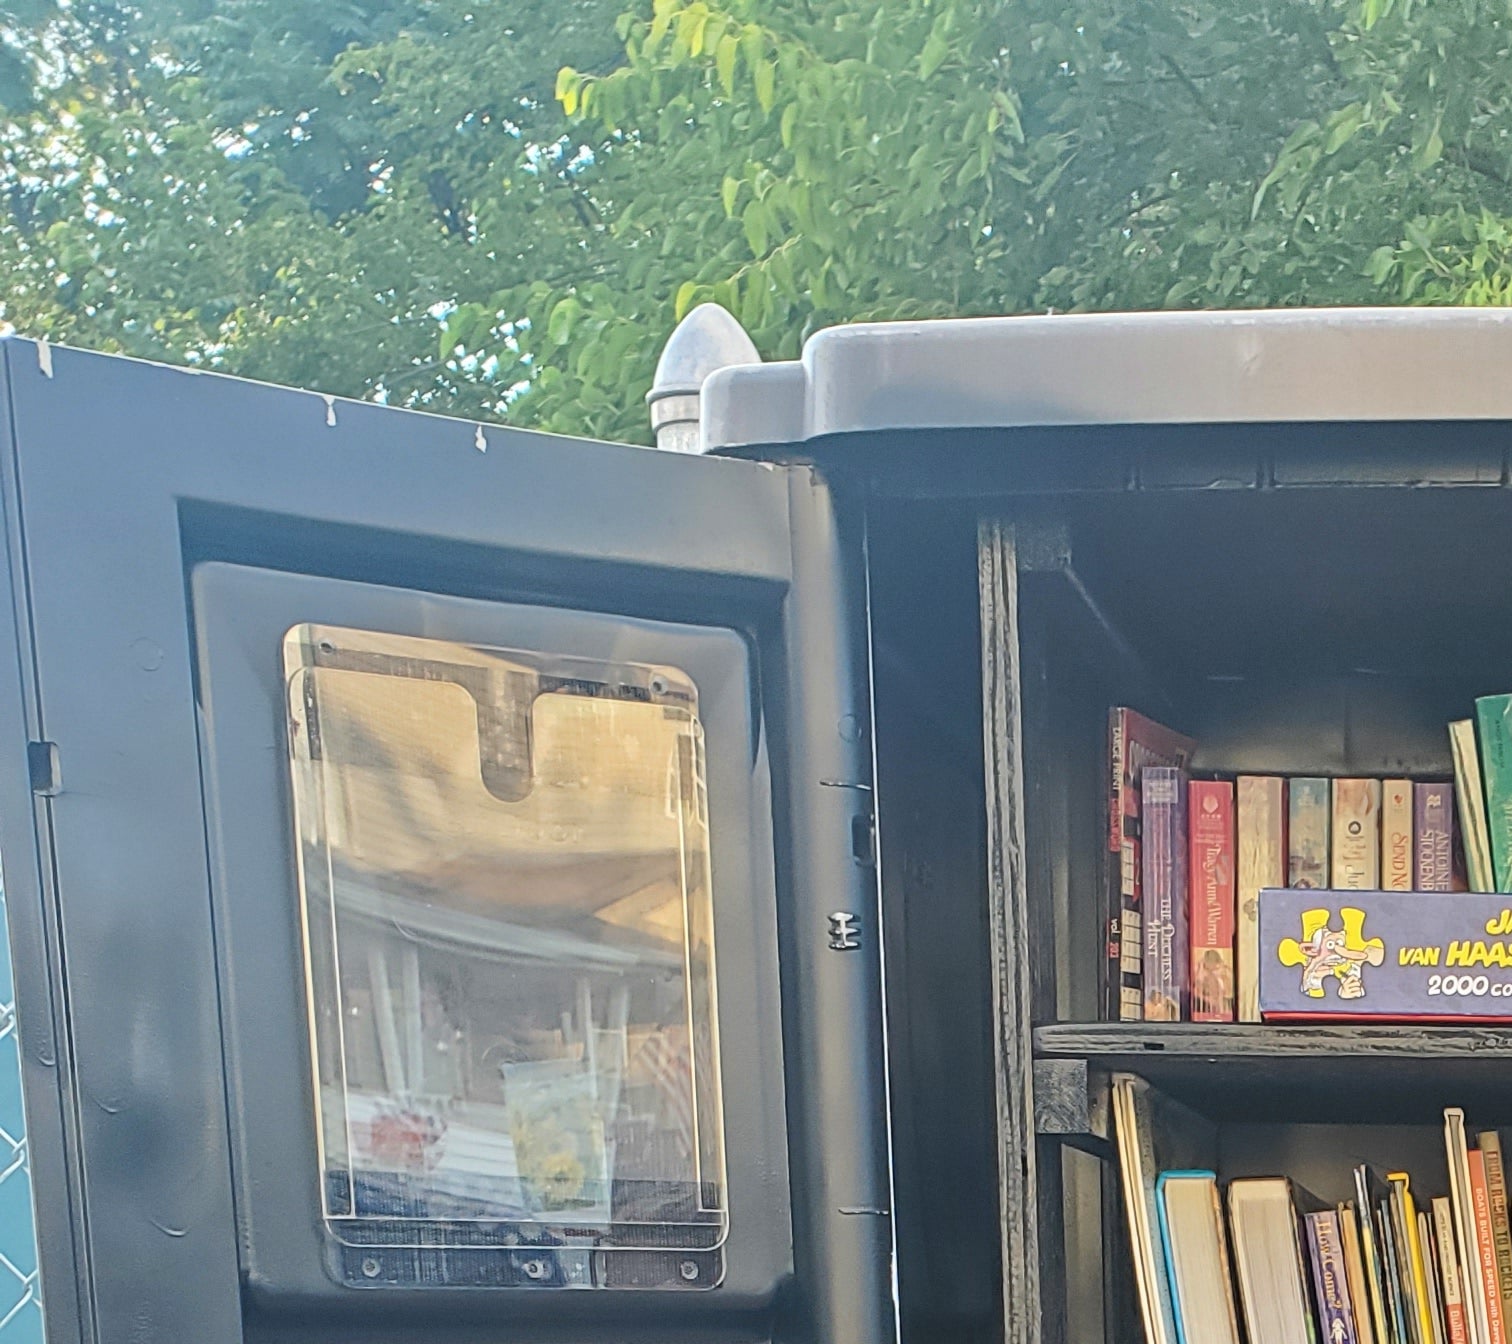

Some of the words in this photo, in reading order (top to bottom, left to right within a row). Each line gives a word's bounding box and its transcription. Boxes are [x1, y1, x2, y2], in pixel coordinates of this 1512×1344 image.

[1398, 946, 1441, 967] VAN
[1427, 974, 1490, 997] 2000
[1475, 1188, 1486, 1217] BOATS
[1478, 1219, 1489, 1245] BUILT
[1482, 1247, 1492, 1265] FOR
[1484, 1267, 1496, 1299] SPEED
[1488, 1300, 1498, 1318] with
